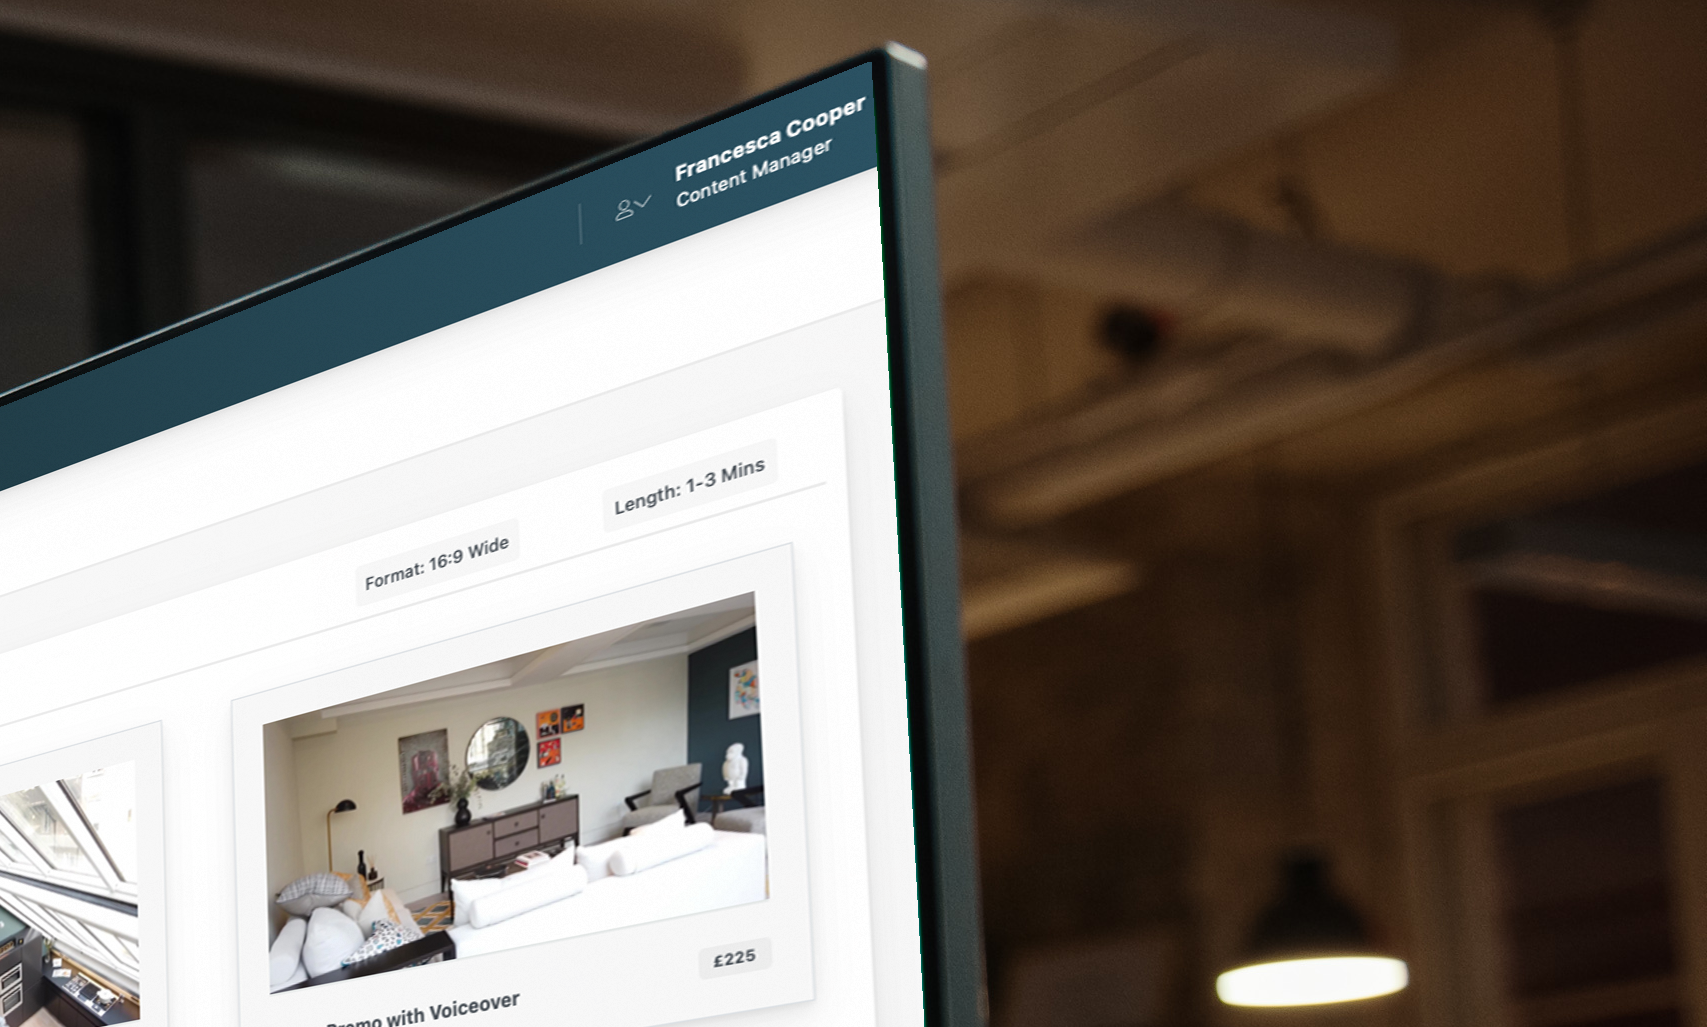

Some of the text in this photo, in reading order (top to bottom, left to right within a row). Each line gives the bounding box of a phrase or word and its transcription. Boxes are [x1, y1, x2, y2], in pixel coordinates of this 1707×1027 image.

[675, 96, 866, 182] Francesca Cooper
[676, 139, 833, 207] Content Manager
[614, 458, 765, 515] Length: 1-3 Mins
[365, 535, 509, 591] Format: 16:9 Wide
[713, 948, 756, 969] £225
[430, 992, 520, 1021] Voiceover
